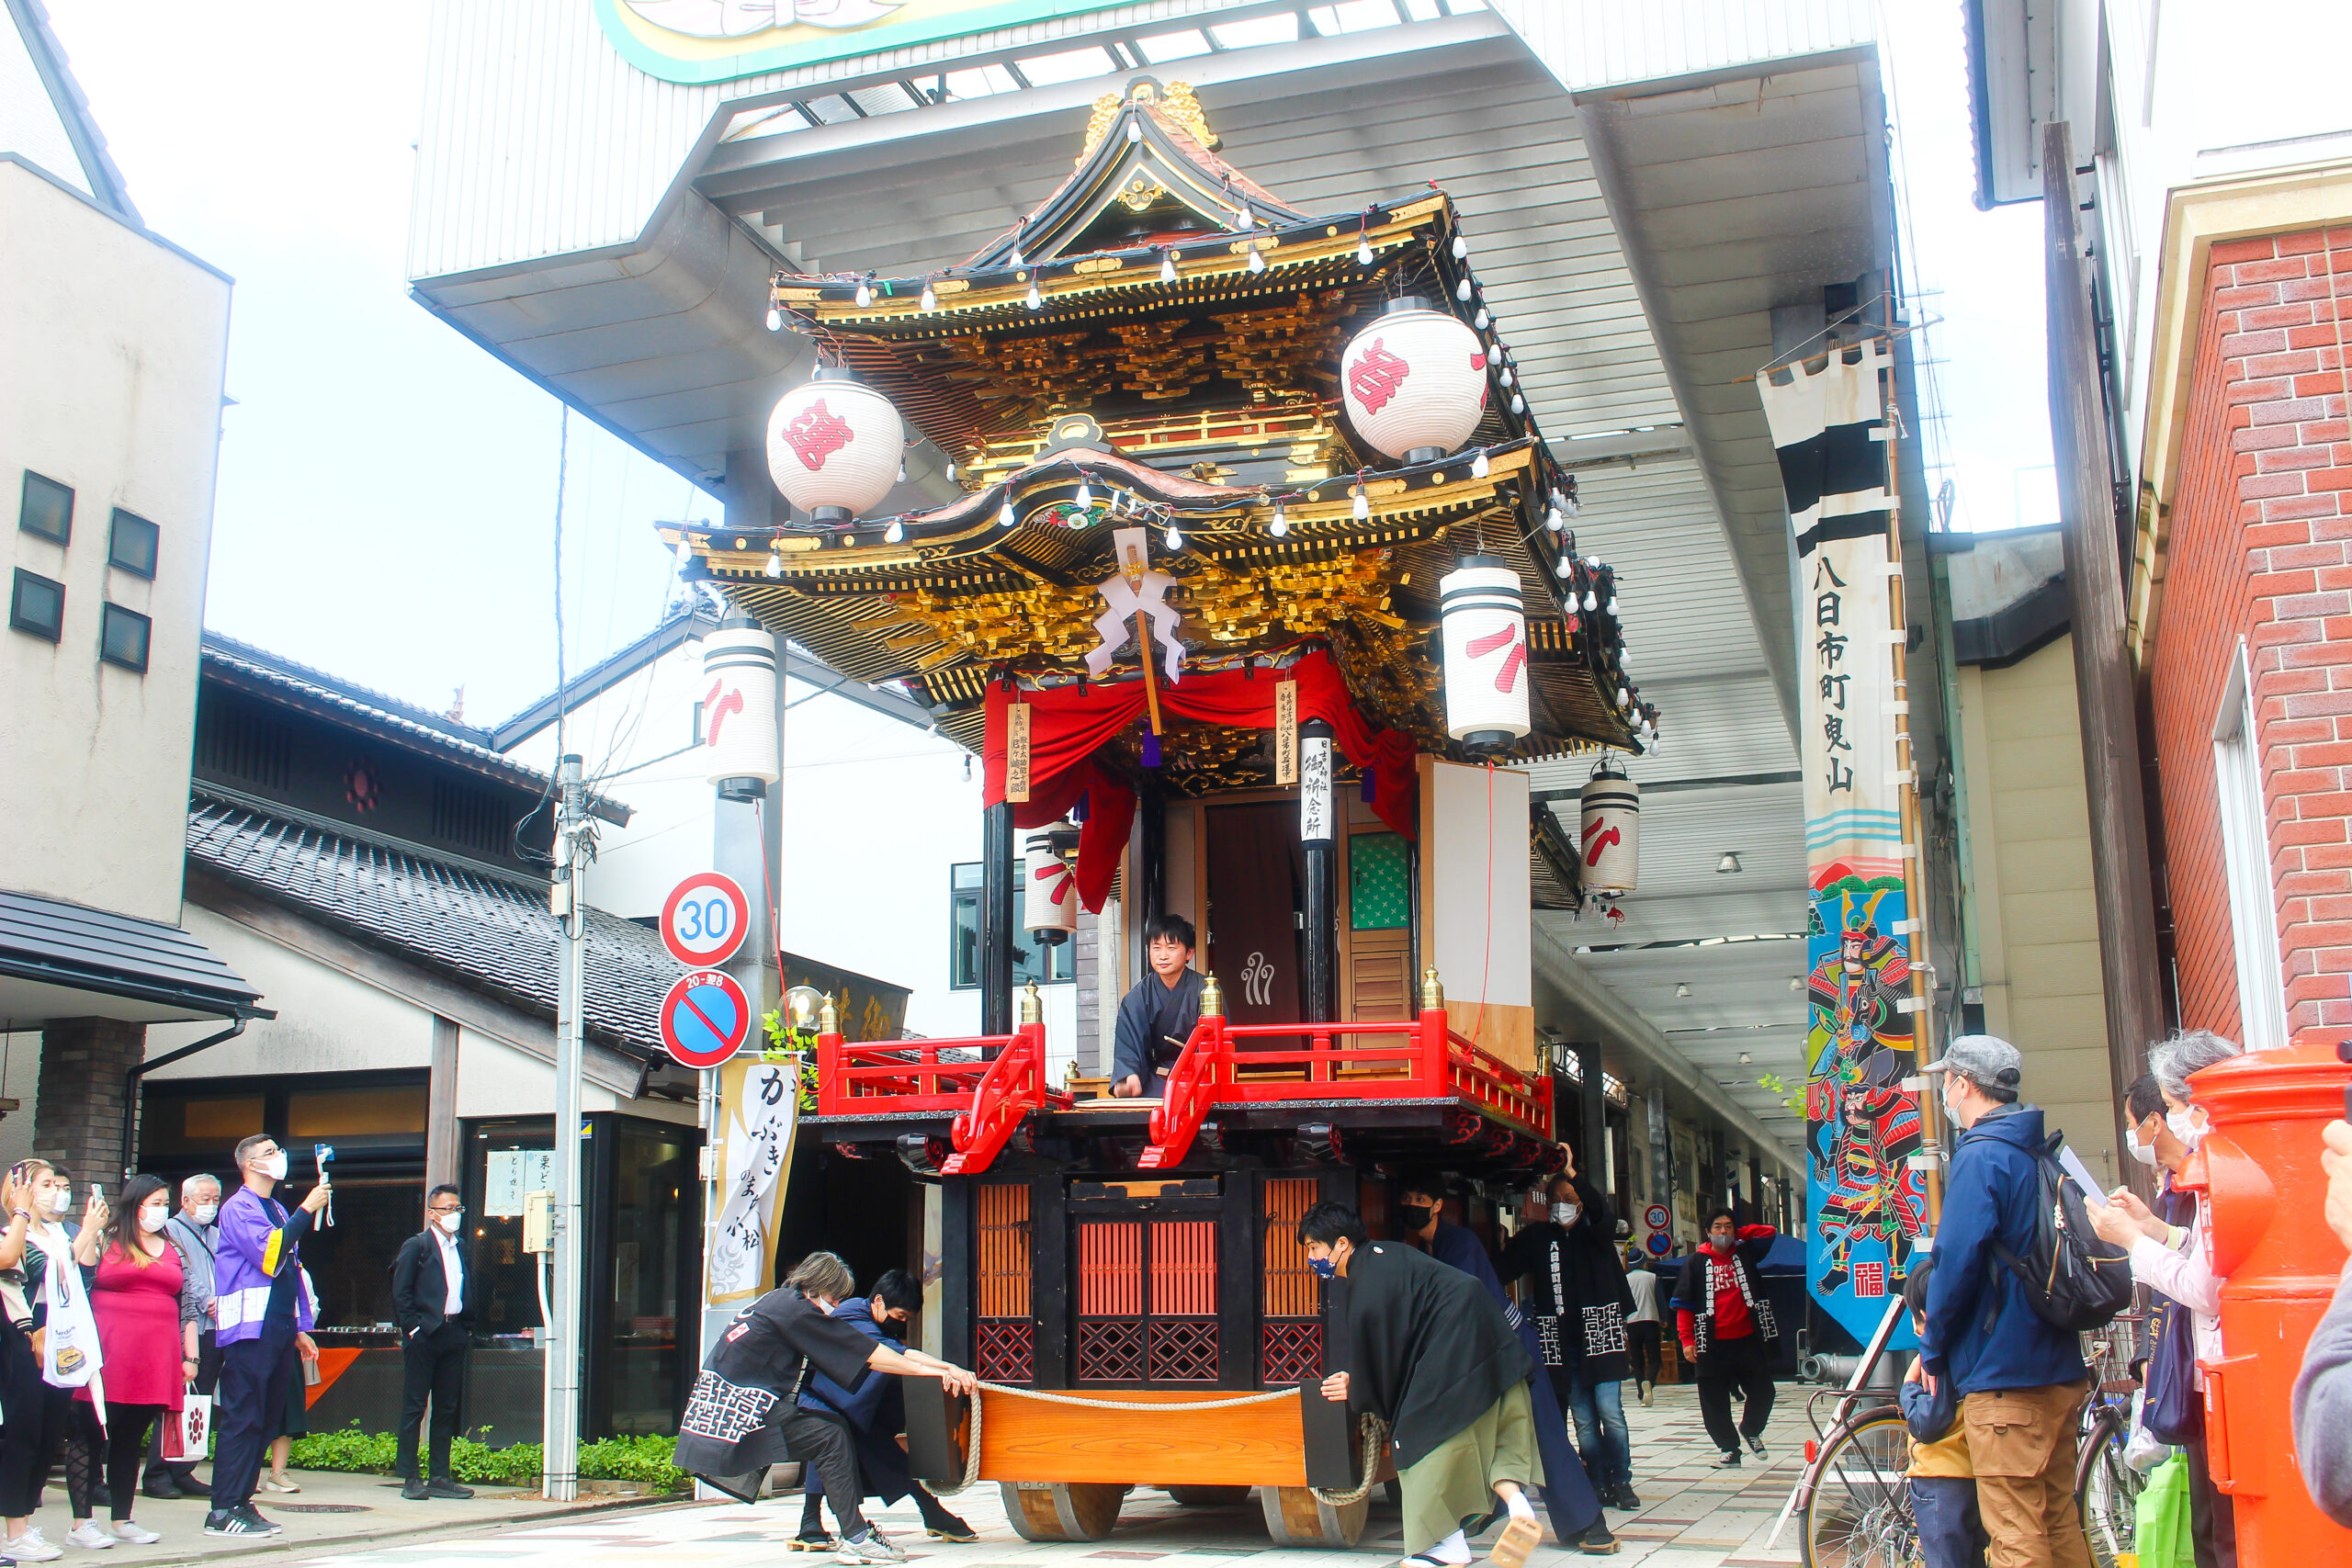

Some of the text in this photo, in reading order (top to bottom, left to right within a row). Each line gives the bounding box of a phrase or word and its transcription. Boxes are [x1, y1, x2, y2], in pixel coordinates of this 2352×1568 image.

[1814, 557, 1854, 795] 八日市町曳山
[1318, 740, 1328, 791] 日吉神社
[681, 898, 728, 941] 30
[1650, 1212, 1665, 1224] 30
